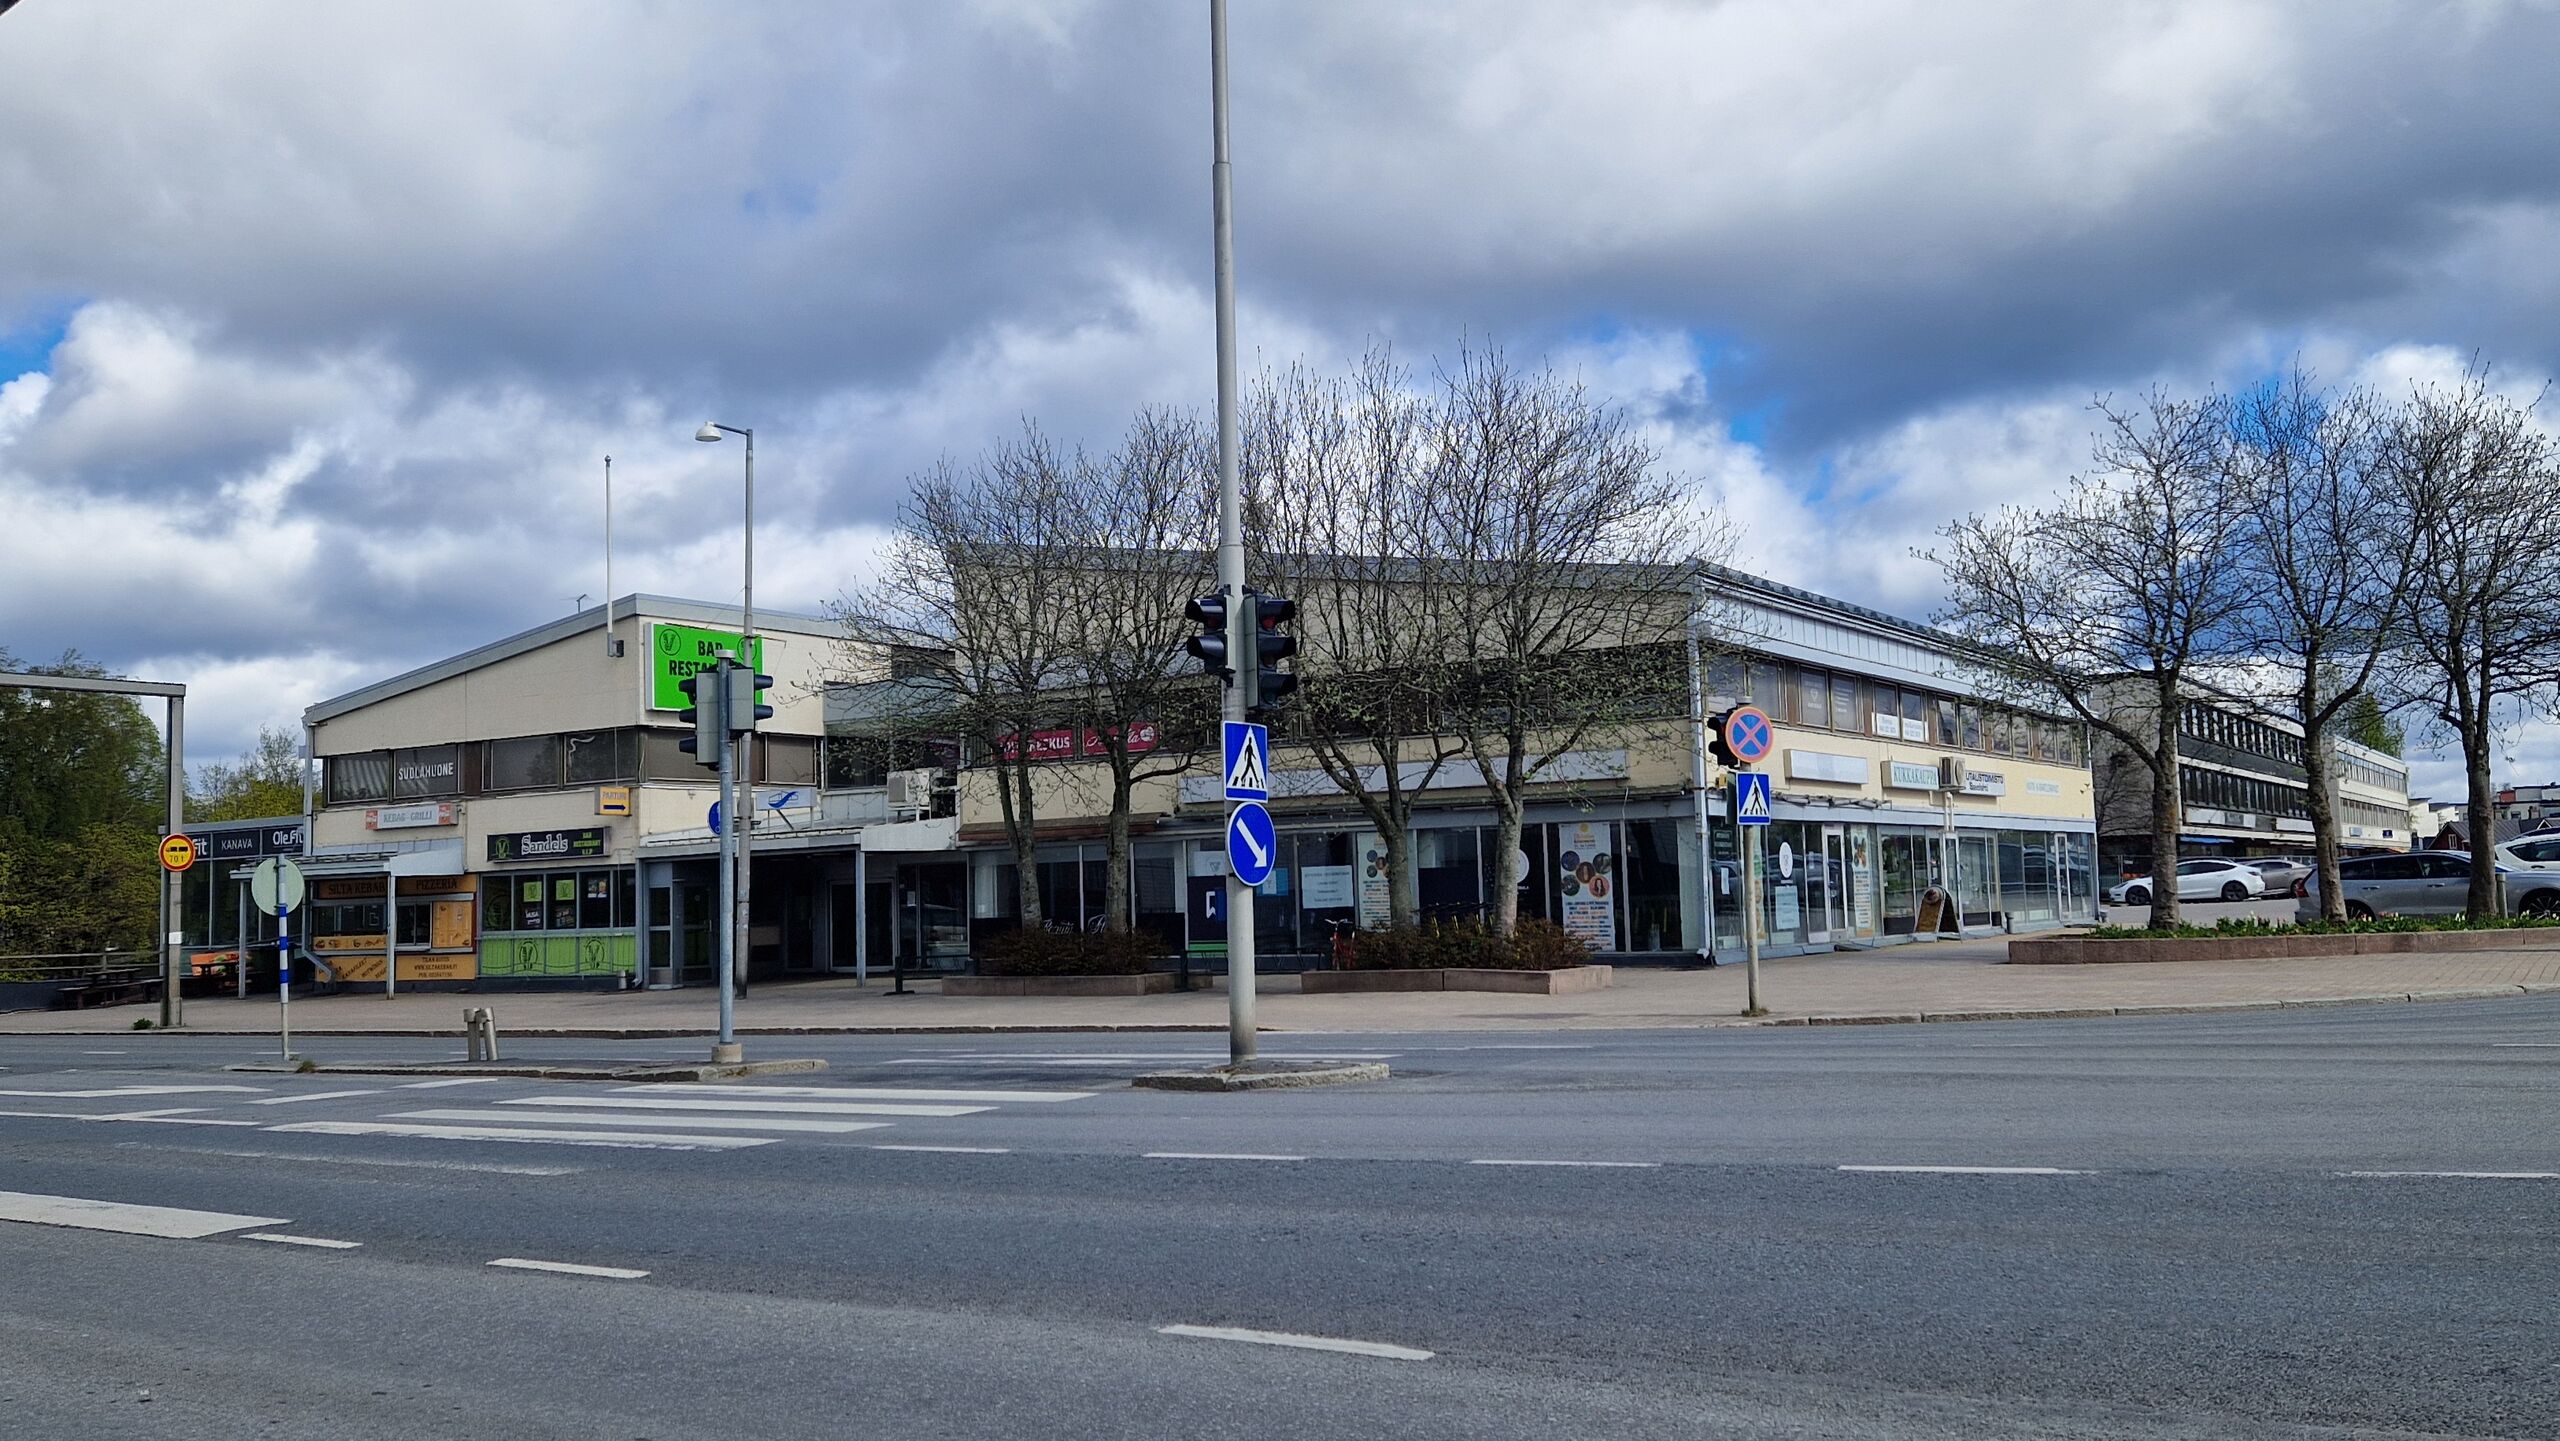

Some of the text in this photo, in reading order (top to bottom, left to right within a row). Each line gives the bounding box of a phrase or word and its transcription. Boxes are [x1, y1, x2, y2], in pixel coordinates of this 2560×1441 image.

[669, 660, 713, 676] RESTA
[1894, 766, 1937, 786] KUKKAKAUPPA
[1966, 772, 2004, 784] UTAUSTOIMISTO
[221, 838, 253, 850] KANAVA
[521, 833, 568, 855] Sandels
[328, 881, 385, 895] SILTA KEBAB
[416, 878, 457, 890] PIZZERIA
